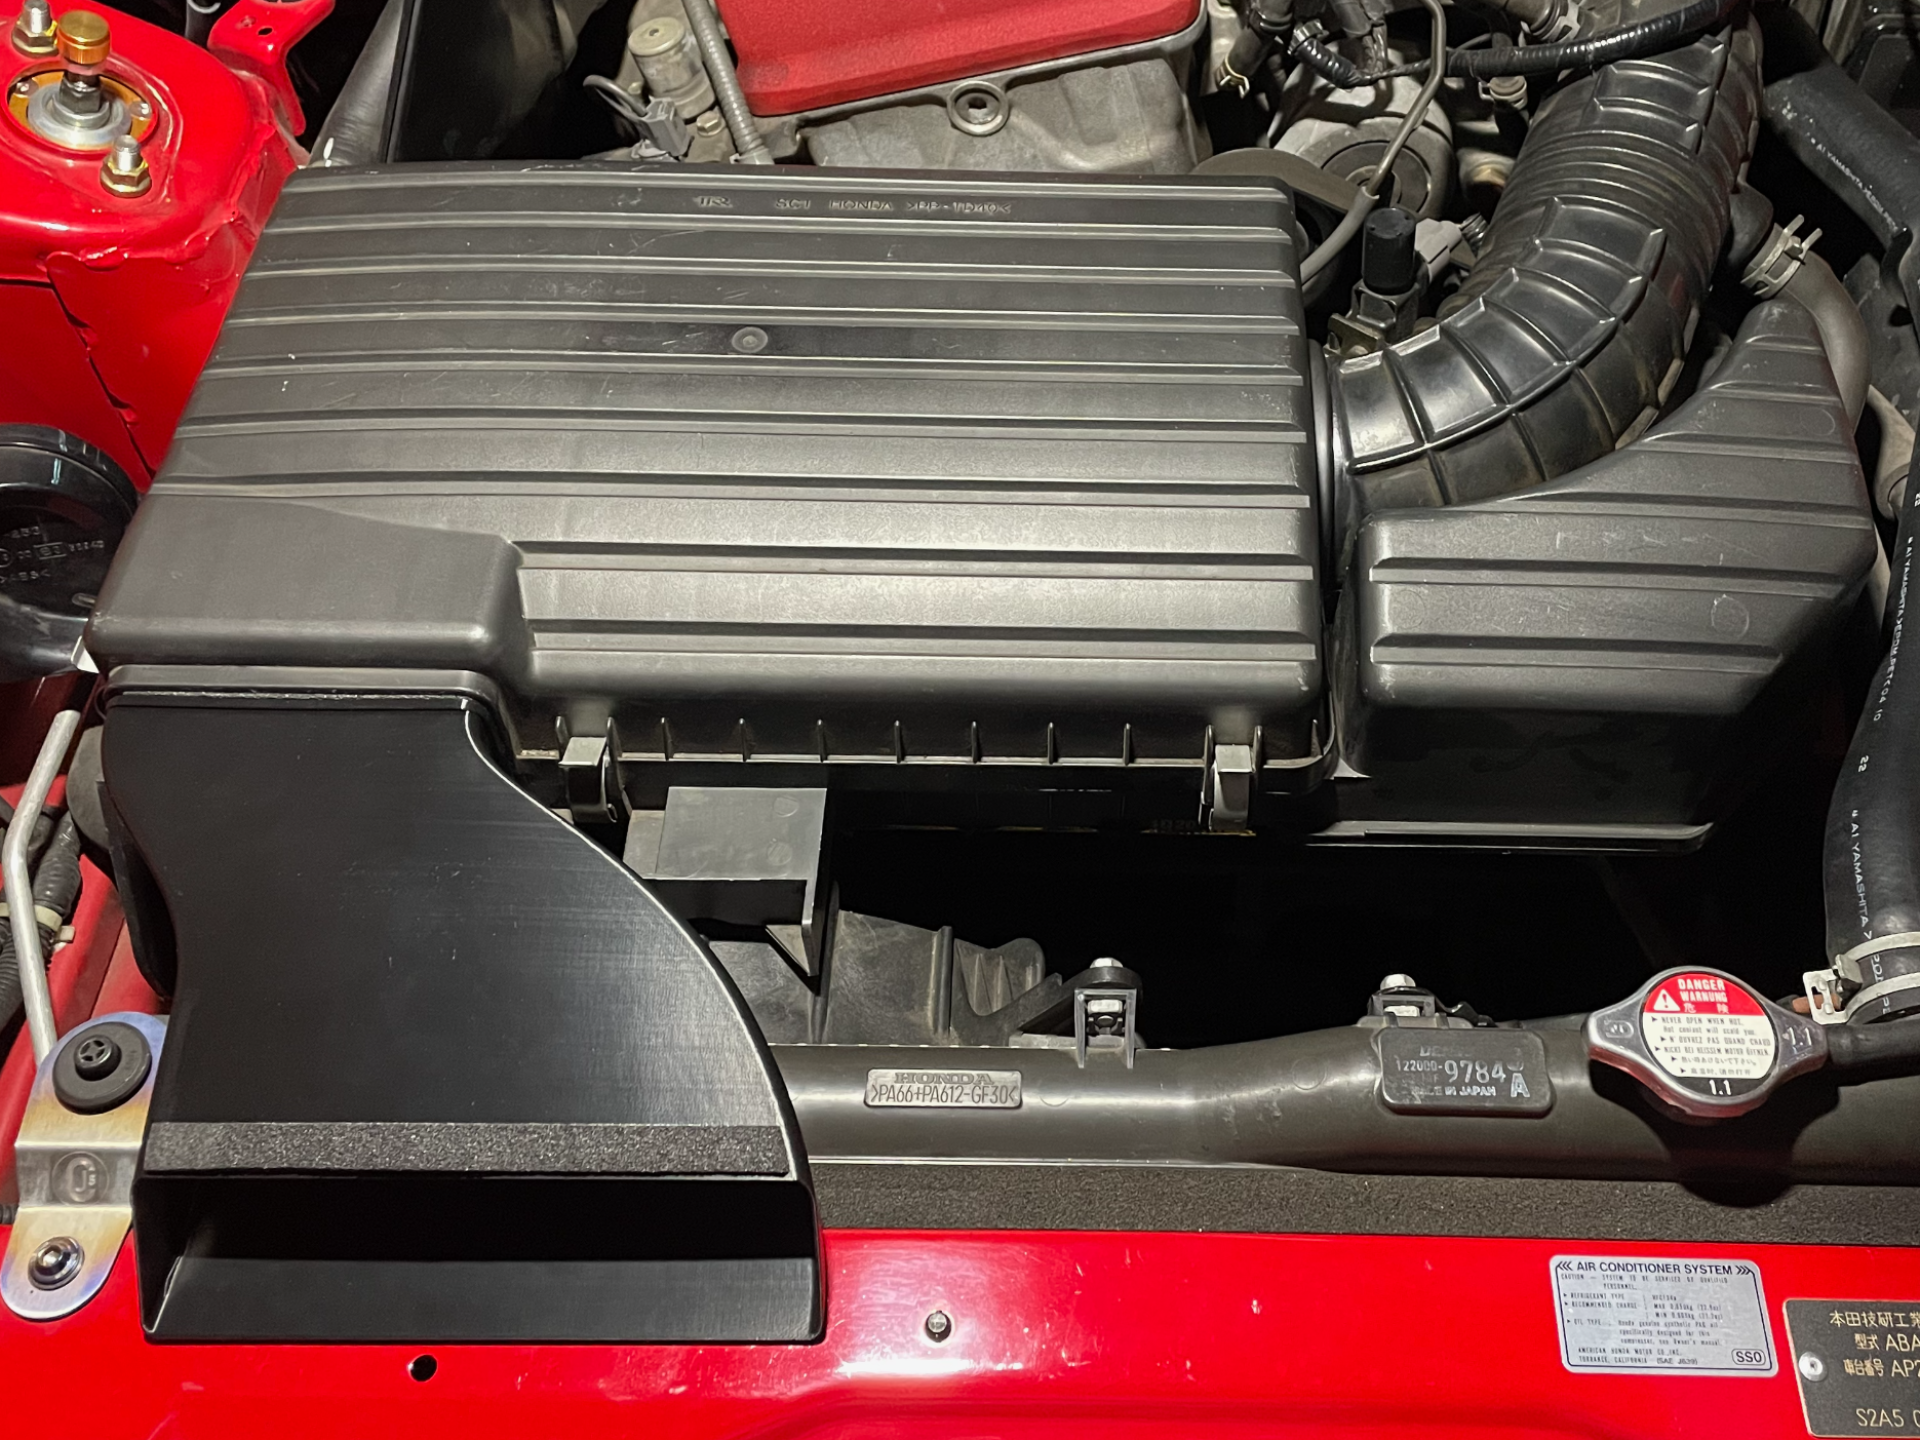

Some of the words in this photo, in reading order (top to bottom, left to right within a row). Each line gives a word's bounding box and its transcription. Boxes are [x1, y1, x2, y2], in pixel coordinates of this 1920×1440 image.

[830, 199, 894, 212] HONDA
[1852, 842, 1869, 928] YAMASHITA
[1678, 979, 1725, 990] DANGER
[1680, 991, 1728, 1003] WARNUNG
[1706, 1017, 1725, 1025] WHEN
[1706, 1026, 1718, 1034] will
[1749, 1038, 1771, 1046] CHAUD
[1685, 1046, 1694, 1054] BEI
[894, 1072, 994, 1085] HONDA
[1459, 1086, 1497, 1096] JAPAN
[1511, 1073, 1530, 1098] A
[1709, 1079, 1732, 1095] 1.1
[1576, 1261, 1596, 1272] AIR
[1600, 1262, 1681, 1274] CONDITIONER
[1684, 1264, 1733, 1275] SYSTEM
[1854, 1333, 1880, 1350] 型式
[1614, 1356, 1647, 1364] CALIFORNIA
[1856, 1408, 1904, 1428] S2A5
